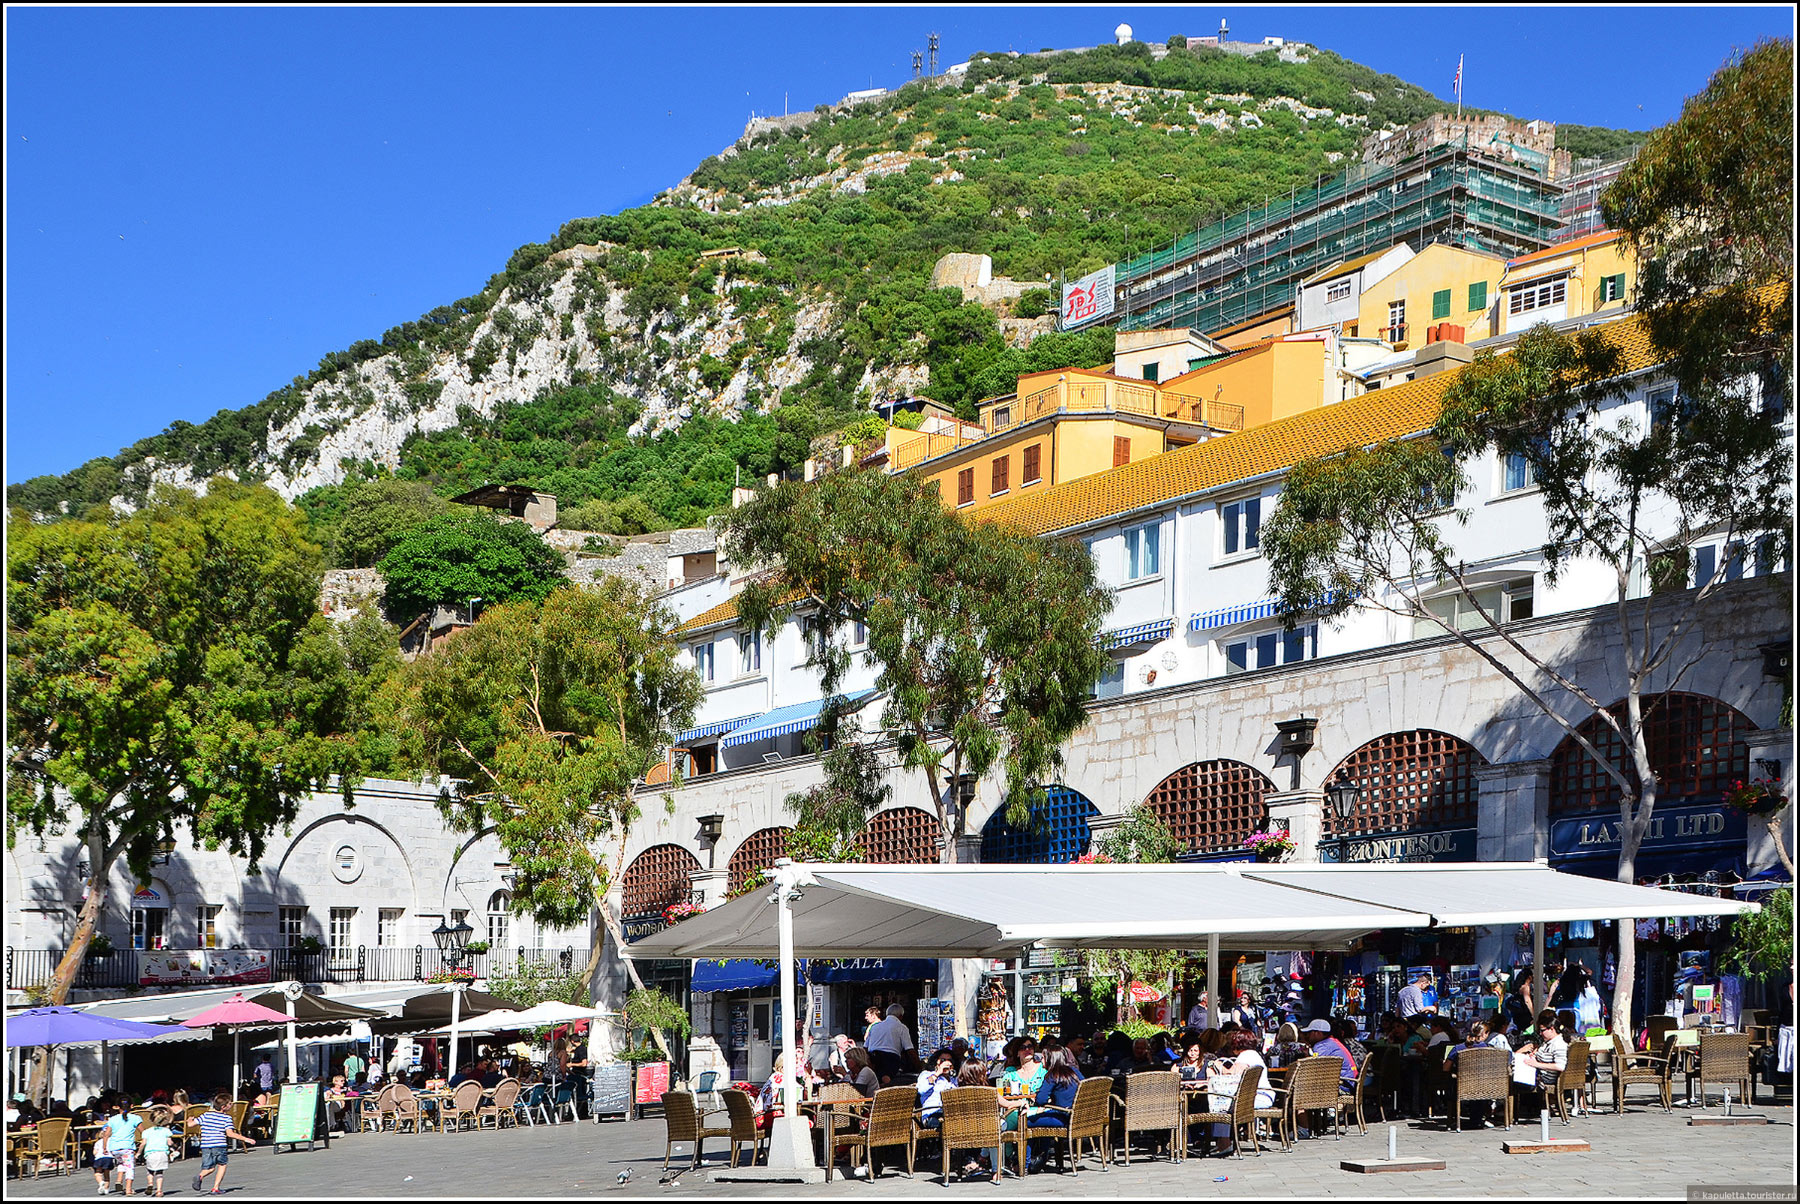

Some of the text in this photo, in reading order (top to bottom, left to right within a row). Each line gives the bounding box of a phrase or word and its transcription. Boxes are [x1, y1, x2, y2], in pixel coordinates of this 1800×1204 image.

[1578, 812, 1725, 845] LAXI LTD
[1348, 833, 1457, 862] MONTESOL
